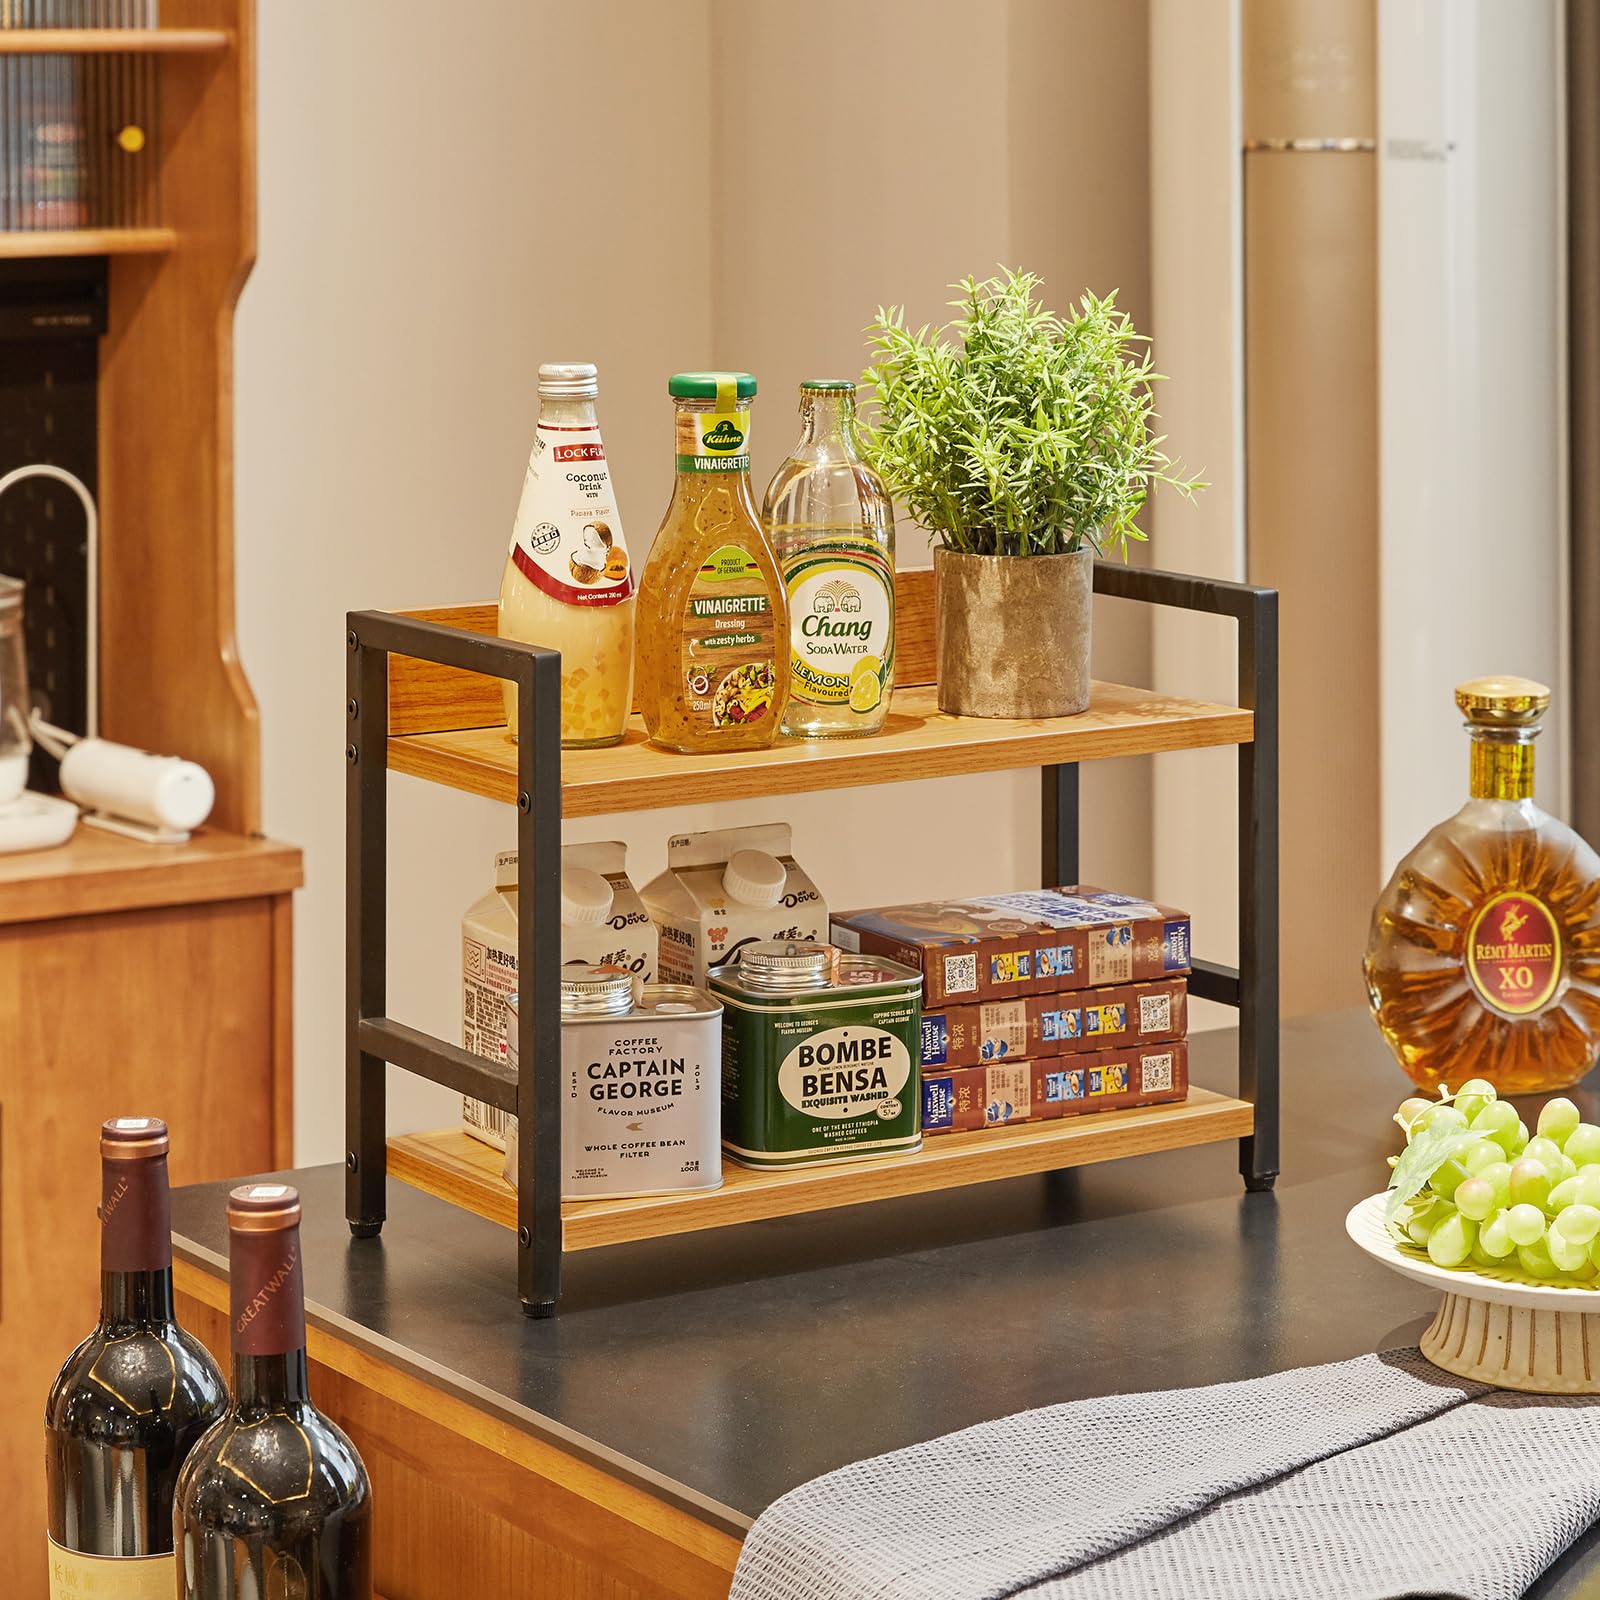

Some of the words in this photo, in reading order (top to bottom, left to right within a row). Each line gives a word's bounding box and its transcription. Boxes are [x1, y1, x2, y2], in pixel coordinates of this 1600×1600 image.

[707, 434, 742, 444] Kühne
[557, 447, 589, 459] LOCK
[694, 455, 749, 470] VINAIGRETTE
[566, 472, 607, 482] Coconut
[579, 482, 602, 491] Drink
[717, 567, 723, 575] OF
[723, 566, 745, 574] GERMANY
[721, 558, 741, 566] PRODUCT
[694, 597, 766, 615] VINAIGRETTE
[715, 618, 746, 630] Dressing
[801, 615, 873, 641] Chang
[704, 638, 716, 646] with
[716, 636, 736, 646] zesty
[735, 634, 755, 644] herbs
[806, 642, 833, 655] SODA
[833, 642, 868, 655] WATER
[793, 659, 850, 688] LEMON
[804, 681, 849, 697] Flavoured
[778, 891, 819, 908] Dove
[605, 913, 649, 930] Dove
[1170, 931, 1178, 960] House
[1177, 926, 1187, 965] Maxwell
[1507, 943, 1552, 958] MARTIN
[1498, 966, 1534, 990] XO
[614, 1038, 658, 1047] COFFEE
[922, 1021, 932, 1060] Maxwell
[932, 1025, 940, 1055] House
[951, 1024, 964, 1050] 特浓
[609, 1046, 663, 1056] FACTORY
[799, 1036, 892, 1068] BOMBE
[587, 1058, 685, 1079] CAPTAIN
[590, 1079, 682, 1101] GEORGE
[802, 1066, 888, 1097] BENSA
[801, 1095, 848, 1108] EXQUISITE
[850, 1091, 889, 1102] WASHED
[929, 1084, 939, 1123] Maxwell
[939, 1088, 947, 1118] House
[958, 1086, 971, 1113] 特浓
[597, 1106, 633, 1116] FLAVOR
[636, 1103, 674, 1116] MUSEUM
[824, 1130, 845, 1138] WASHED
[845, 1127, 868, 1135] COFFEES
[855, 1120, 879, 1128] ETHIOPIA
[584, 1144, 618, 1152] WHOLE
[621, 1141, 657, 1149] COFFEE
[659, 1139, 686, 1147] BEAN
